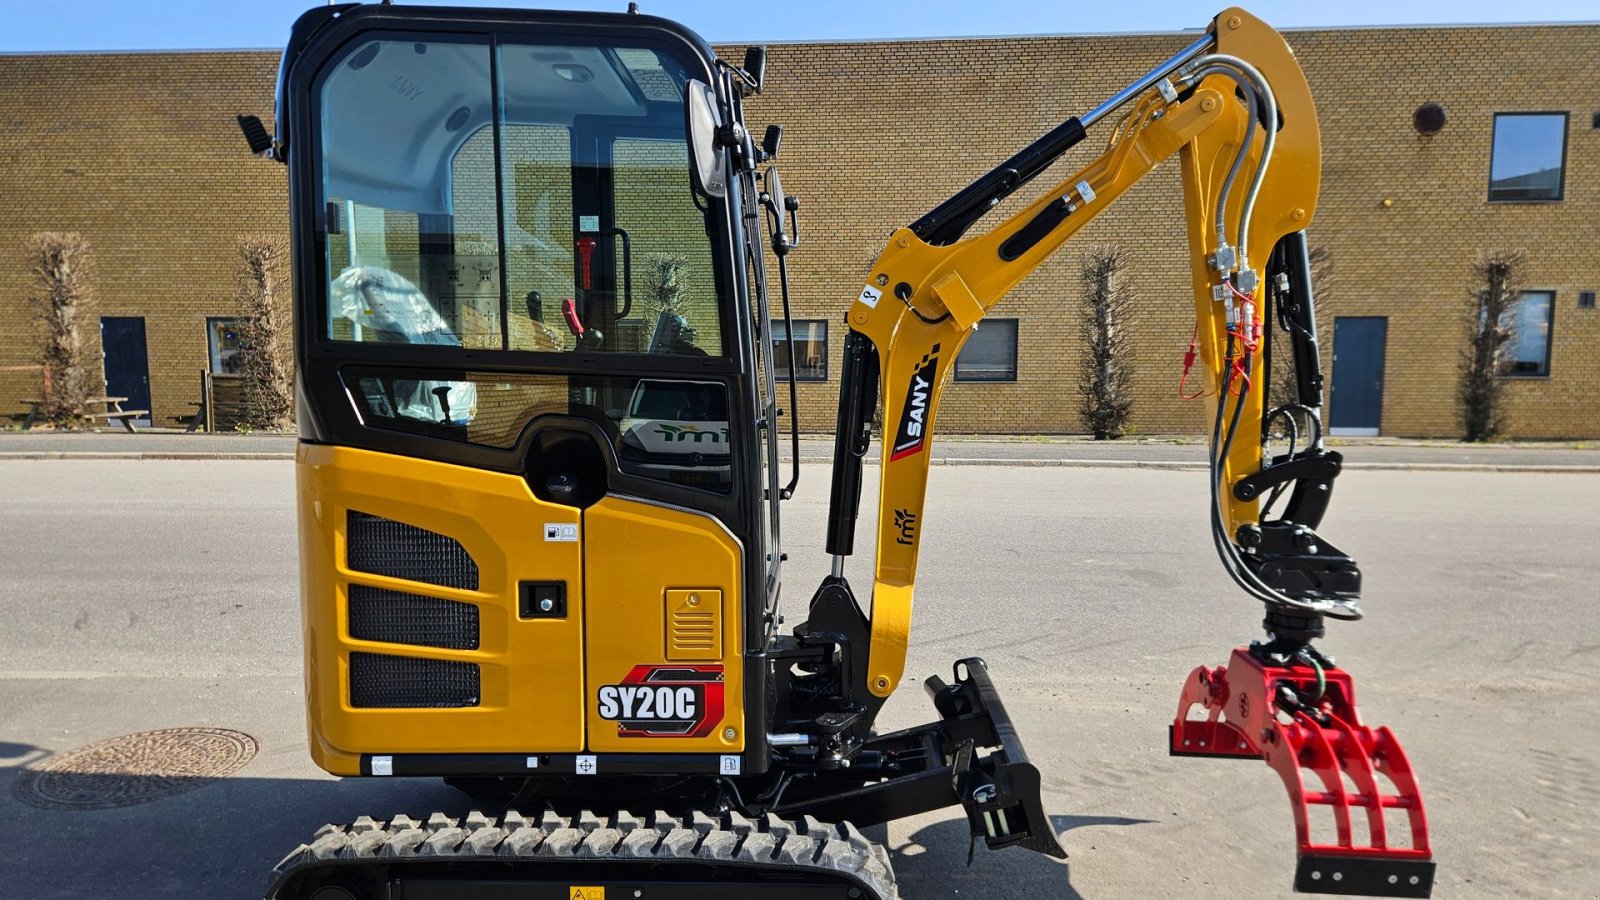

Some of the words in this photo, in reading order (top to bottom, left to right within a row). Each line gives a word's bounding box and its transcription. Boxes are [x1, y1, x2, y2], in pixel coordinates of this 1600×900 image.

[907, 376, 929, 437] SANY
[895, 508, 916, 546] fmr
[600, 686, 695, 719] SY20C
